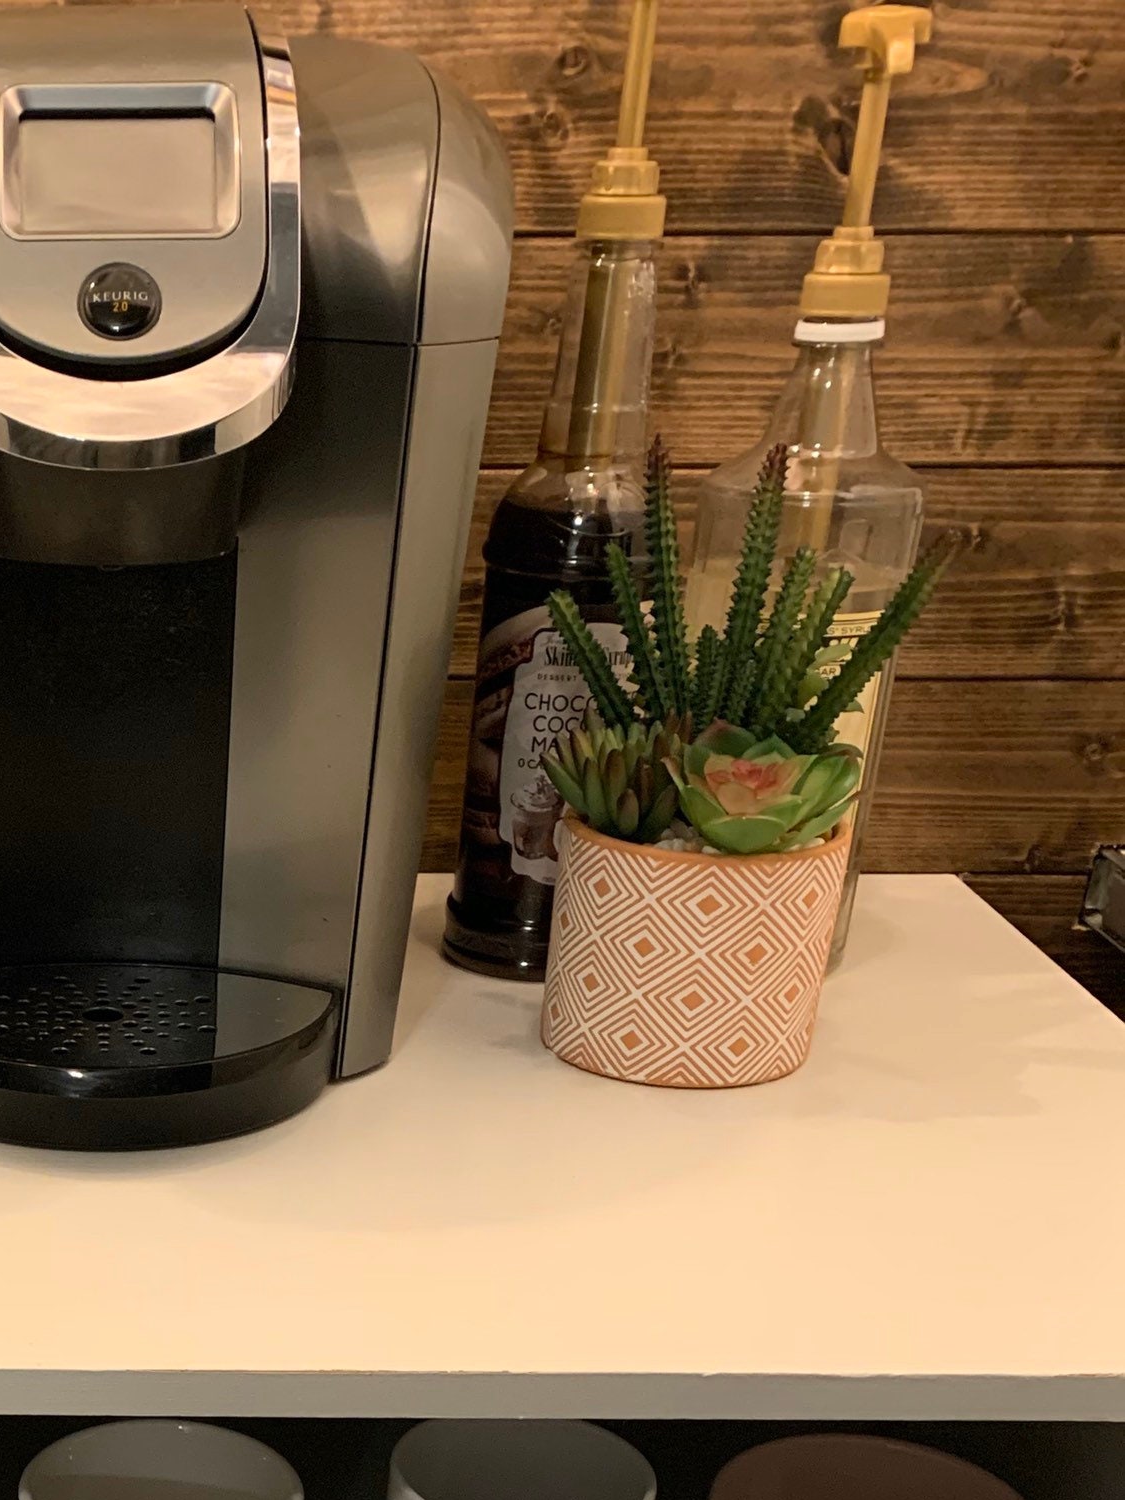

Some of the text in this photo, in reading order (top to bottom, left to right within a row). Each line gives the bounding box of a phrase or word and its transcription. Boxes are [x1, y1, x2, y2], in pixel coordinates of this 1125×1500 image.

[93, 291, 148, 302] KEURIG
[113, 301, 128, 312] 2.0
[532, 736, 558, 753] MA
